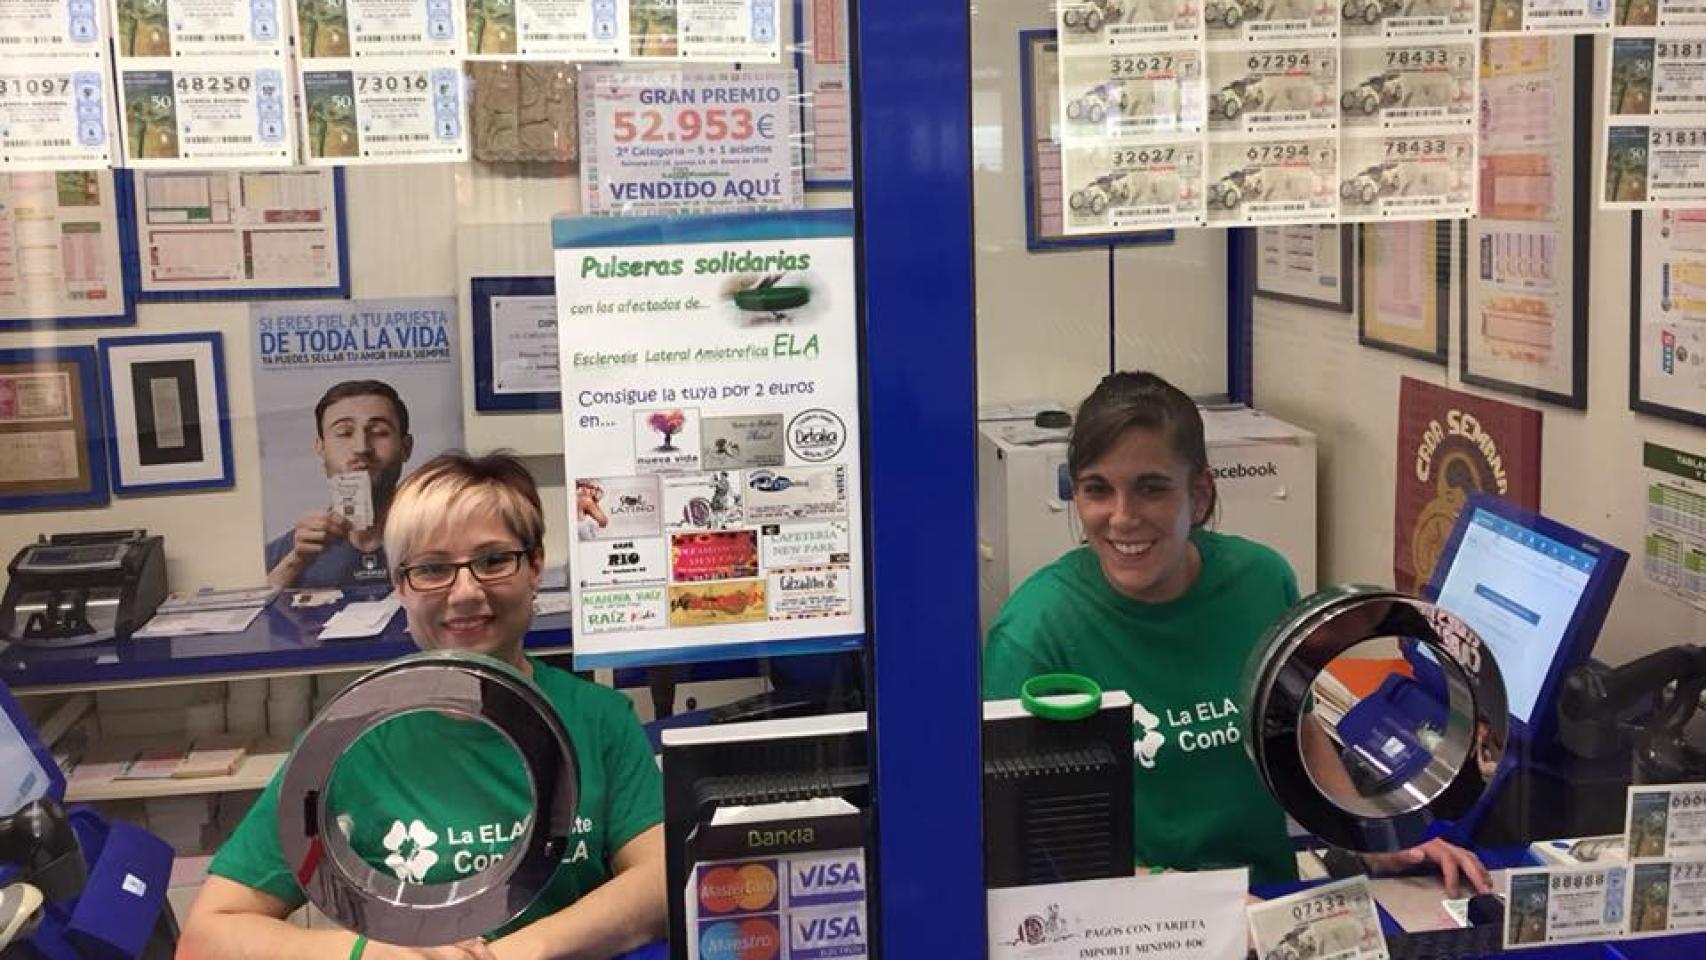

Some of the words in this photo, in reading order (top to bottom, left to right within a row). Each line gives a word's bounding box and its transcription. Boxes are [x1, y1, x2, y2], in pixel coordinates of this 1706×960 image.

[1111, 56, 1174, 73] 32627
[1248, 54, 1310, 70] 67294
[1385, 49, 1448, 66] 78433
[177, 76, 250, 93] 48250
[357, 75, 427, 93] 73016
[639, 88, 695, 105] GRAN
[702, 86, 780, 104] PREMIO
[613, 107, 776, 142] 52.953€
[1112, 147, 1175, 165] 32627
[1247, 143, 1310, 161] 67294
[1384, 139, 1446, 156] 78433
[609, 180, 717, 201] VENDIDO
[723, 172, 782, 200] AQUÍ
[581, 254, 684, 279] Pulseras
[694, 249, 811, 275] solidarias
[570, 303, 593, 316] con
[596, 299, 614, 314] los
[617, 298, 681, 313] afectados
[260, 318, 272, 331] SI
[276, 315, 313, 331] ERES
[317, 314, 346, 329] FIEL
[350, 314, 359, 328] A
[361, 312, 380, 327] TU
[386, 311, 448, 327] APUESTA
[260, 331, 289, 354] DE
[295, 329, 357, 353] TODA
[363, 328, 391, 350] LA
[395, 326, 449, 349] VIDA
[361, 351, 387, 361] AMOR
[573, 350, 637, 367] Esclerosis
[645, 348, 691, 363] Lateral
[772, 333, 820, 358] ELA
[578, 387, 657, 408] Consigue
[662, 387, 676, 402] la
[681, 384, 718, 404] tuya
[722, 382, 751, 401] por
[755, 383, 764, 397] 2
[768, 380, 815, 397] euros
[579, 415, 616, 428] en...
[1416, 419, 1444, 482] CADA
[1447, 408, 1508, 495] SEMANA
[1211, 462, 1277, 479] acebook
[803, 543, 834, 554] PARK
[608, 553, 640, 566] RIO
[1167, 707, 1192, 727] La
[1196, 698, 1240, 721] ELA
[1178, 722, 1241, 751] Conó
[447, 826, 474, 845] La
[479, 822, 525, 844] ELA
[748, 827, 815, 847] Bankia
[799, 862, 861, 888] VISA
[800, 916, 861, 942] VISA
[1085, 927, 1123, 938] PAGOS
[1126, 924, 1151, 935] CON
[1156, 919, 1205, 932] TARJETA
[708, 935, 769, 953] Maestro
[1080, 945, 1129, 958] IMPORTE
